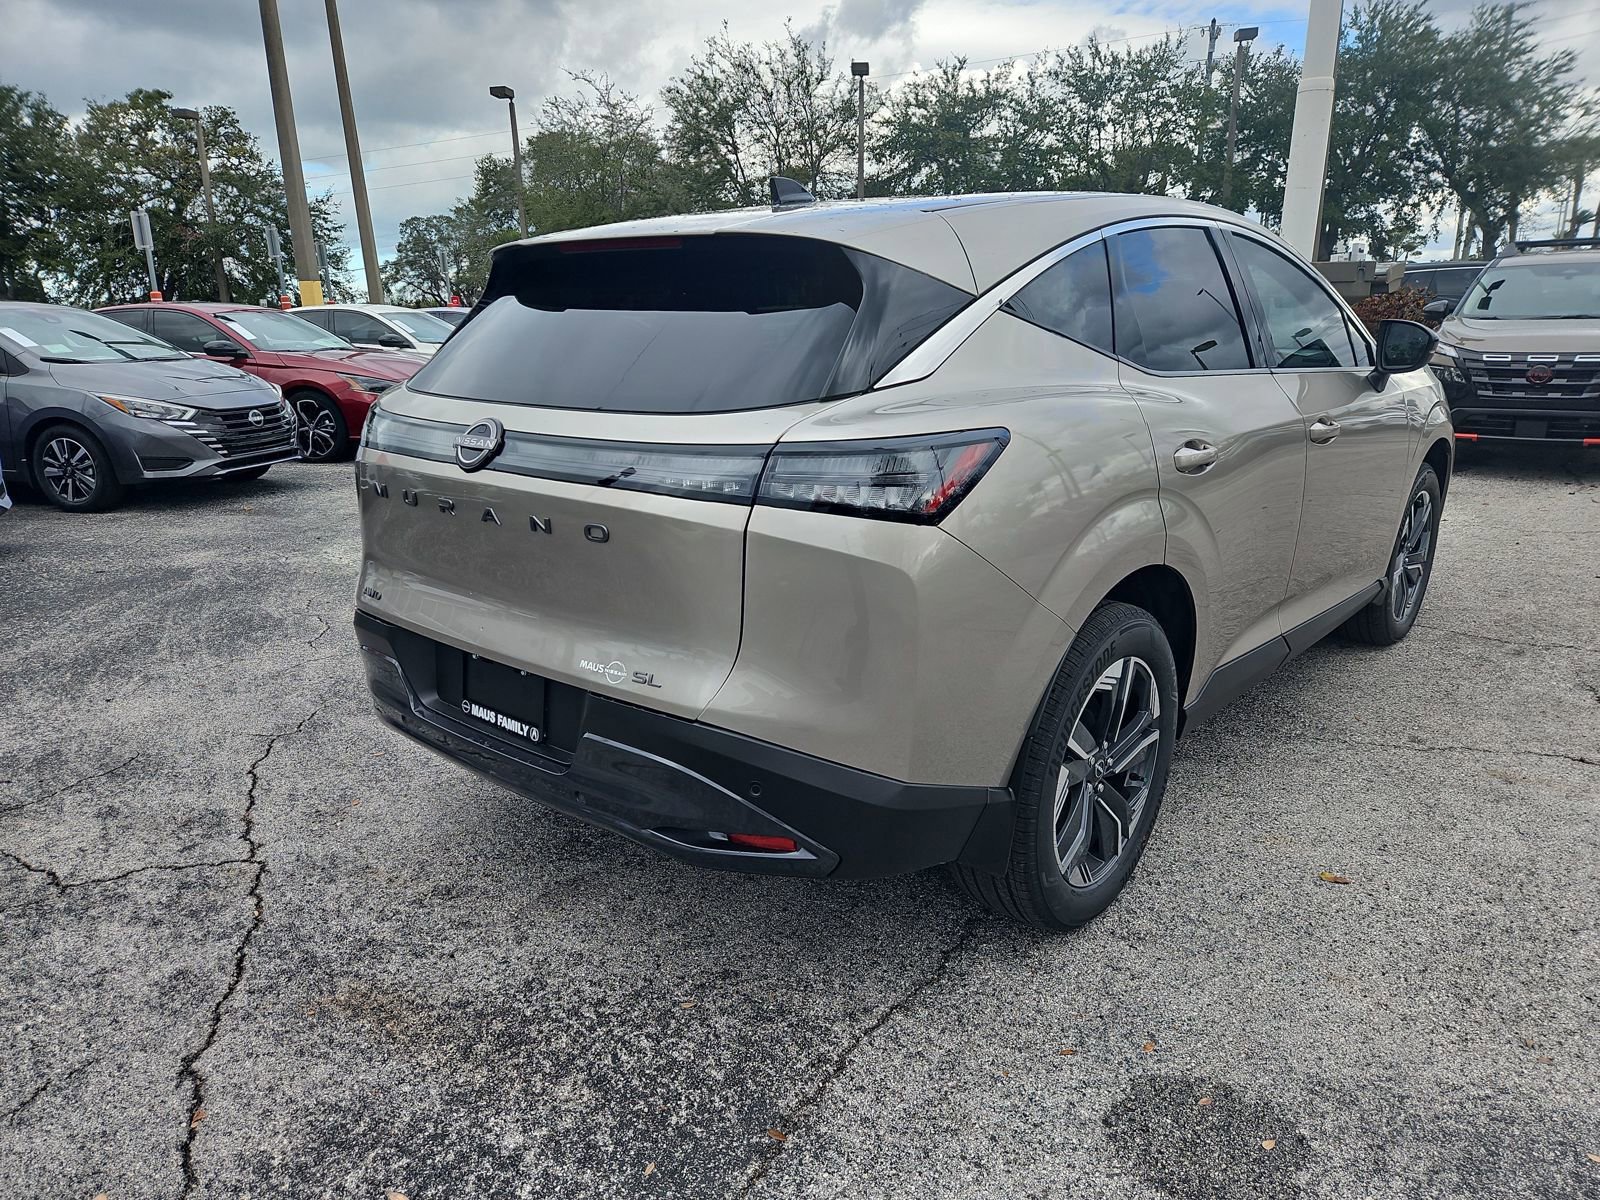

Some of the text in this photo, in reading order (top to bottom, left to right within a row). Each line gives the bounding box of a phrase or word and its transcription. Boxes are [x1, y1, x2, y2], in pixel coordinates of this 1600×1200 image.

[455, 436, 496, 450] NISSAN
[374, 481, 610, 544] MURANO
[579, 659, 605, 673] MAUS
[631, 671, 662, 689] SL
[471, 703, 530, 737] MAUS FAMILY
